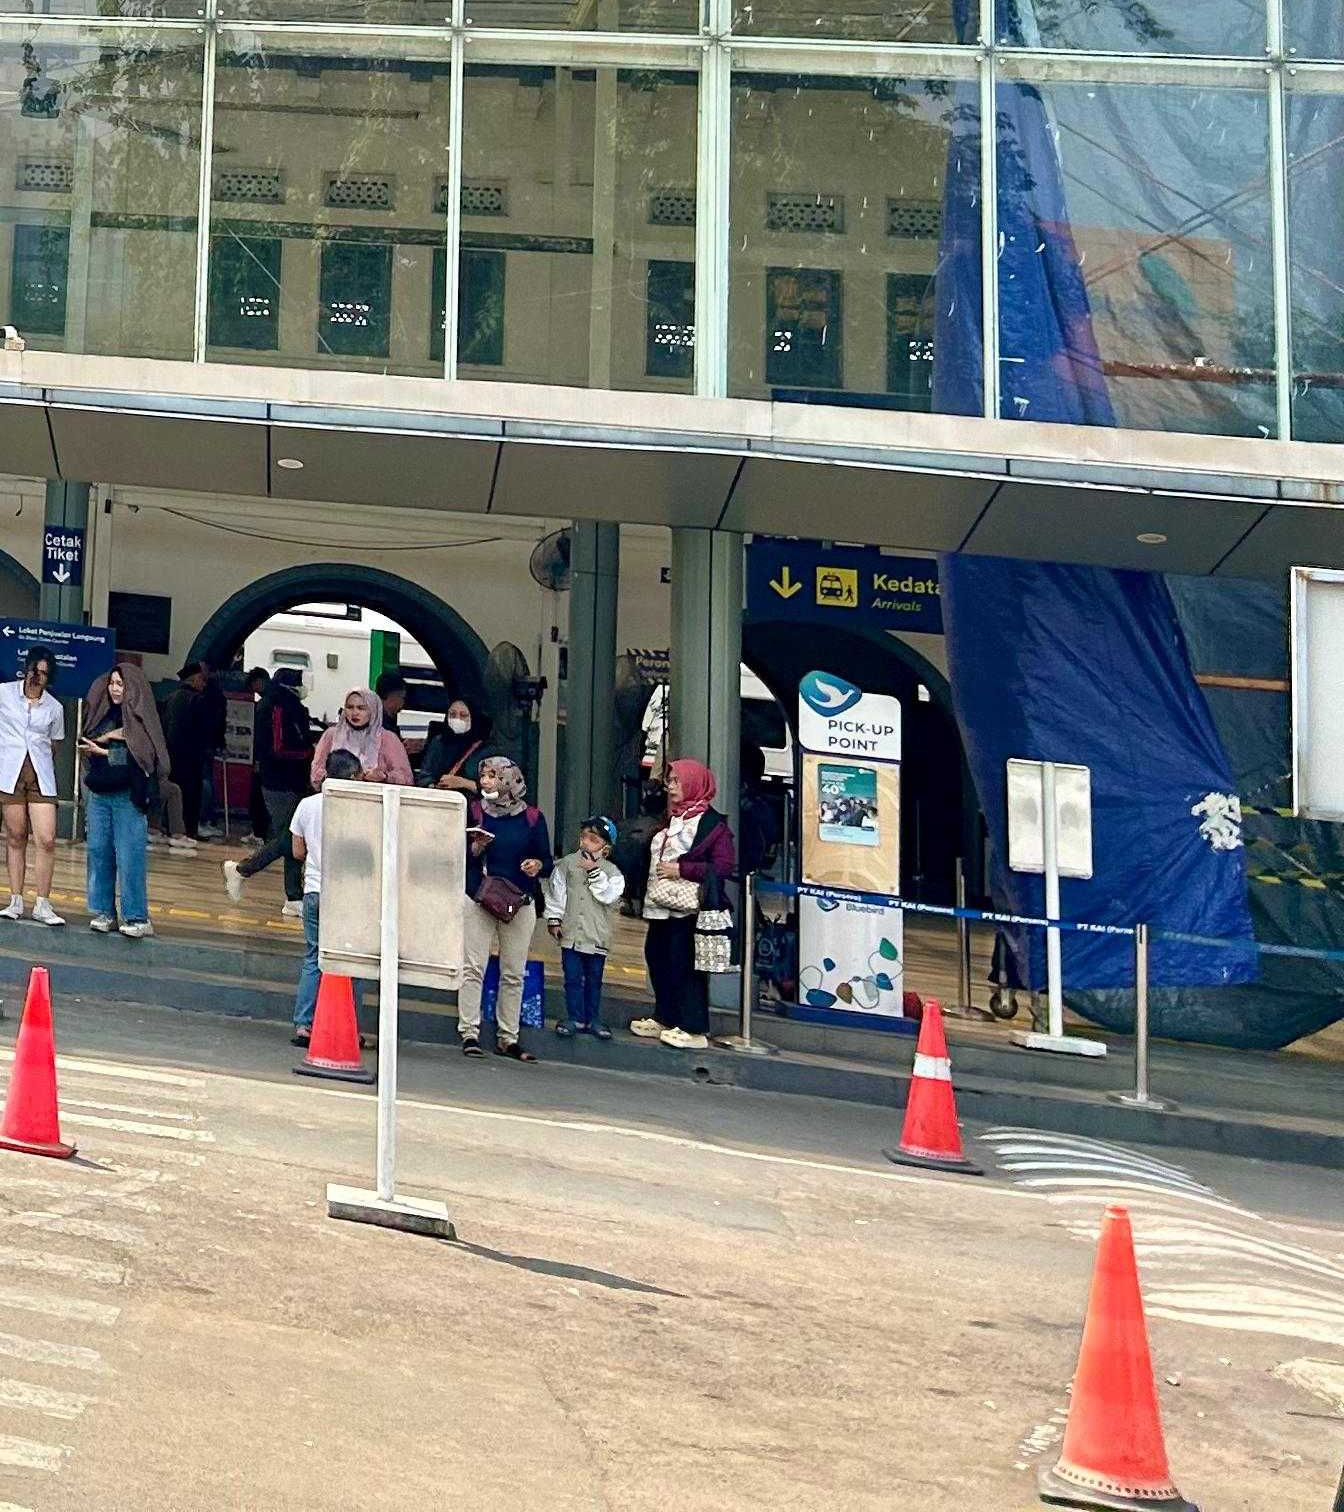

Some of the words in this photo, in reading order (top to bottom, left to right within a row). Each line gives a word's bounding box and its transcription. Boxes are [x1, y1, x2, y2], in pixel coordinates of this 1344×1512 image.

[44, 532, 82, 549] Cetak
[47, 546, 79, 563] Tiket
[872, 573, 941, 596] Kedata
[871, 596, 922, 612] Arrivals
[827, 719, 894, 737] PICK-UP
[827, 736, 879, 752] POINT
[797, 886, 809, 894] PT
[888, 899, 900, 907] PT
[981, 911, 994, 920] PT
[1076, 923, 1088, 931] PT
